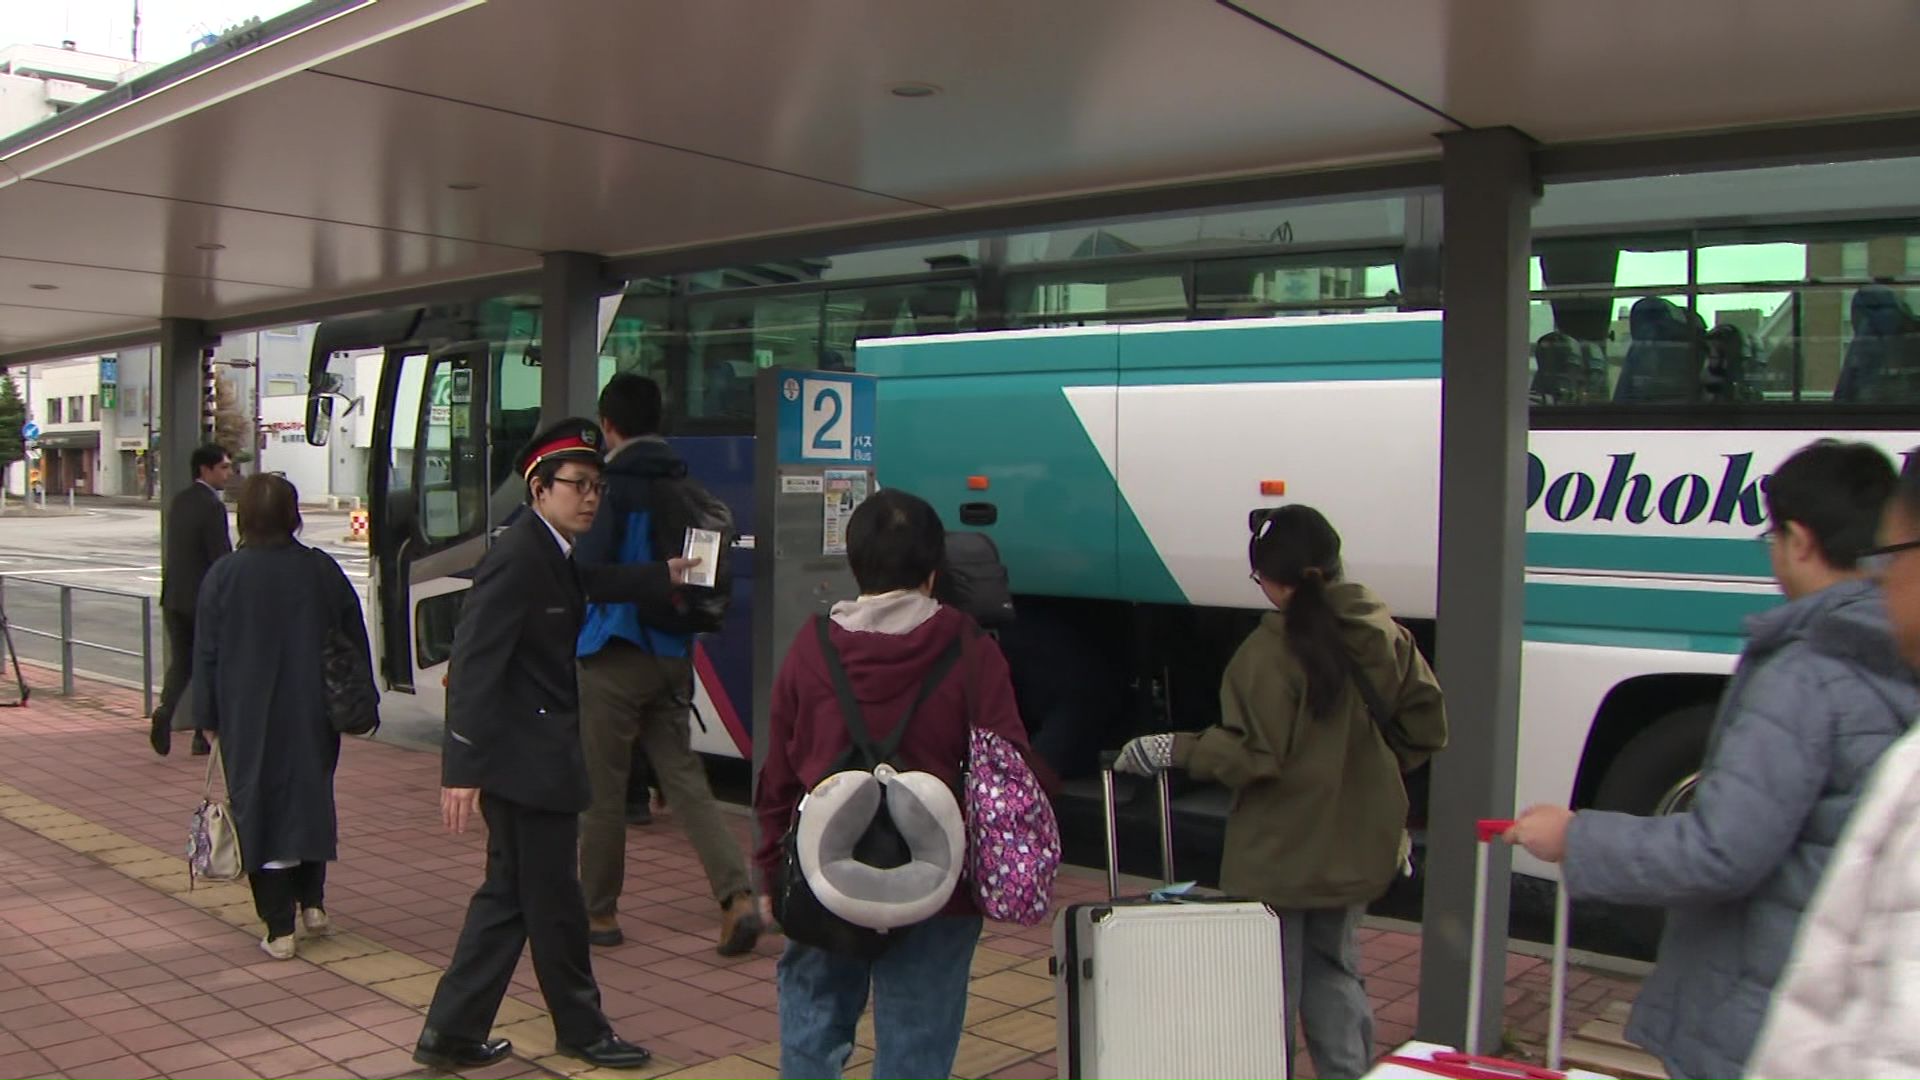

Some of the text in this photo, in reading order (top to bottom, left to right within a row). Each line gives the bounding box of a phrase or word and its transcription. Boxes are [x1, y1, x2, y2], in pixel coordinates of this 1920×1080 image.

[812, 388, 842, 449] 2
[854, 435, 872, 448] バス
[854, 450, 872, 461] Bus
